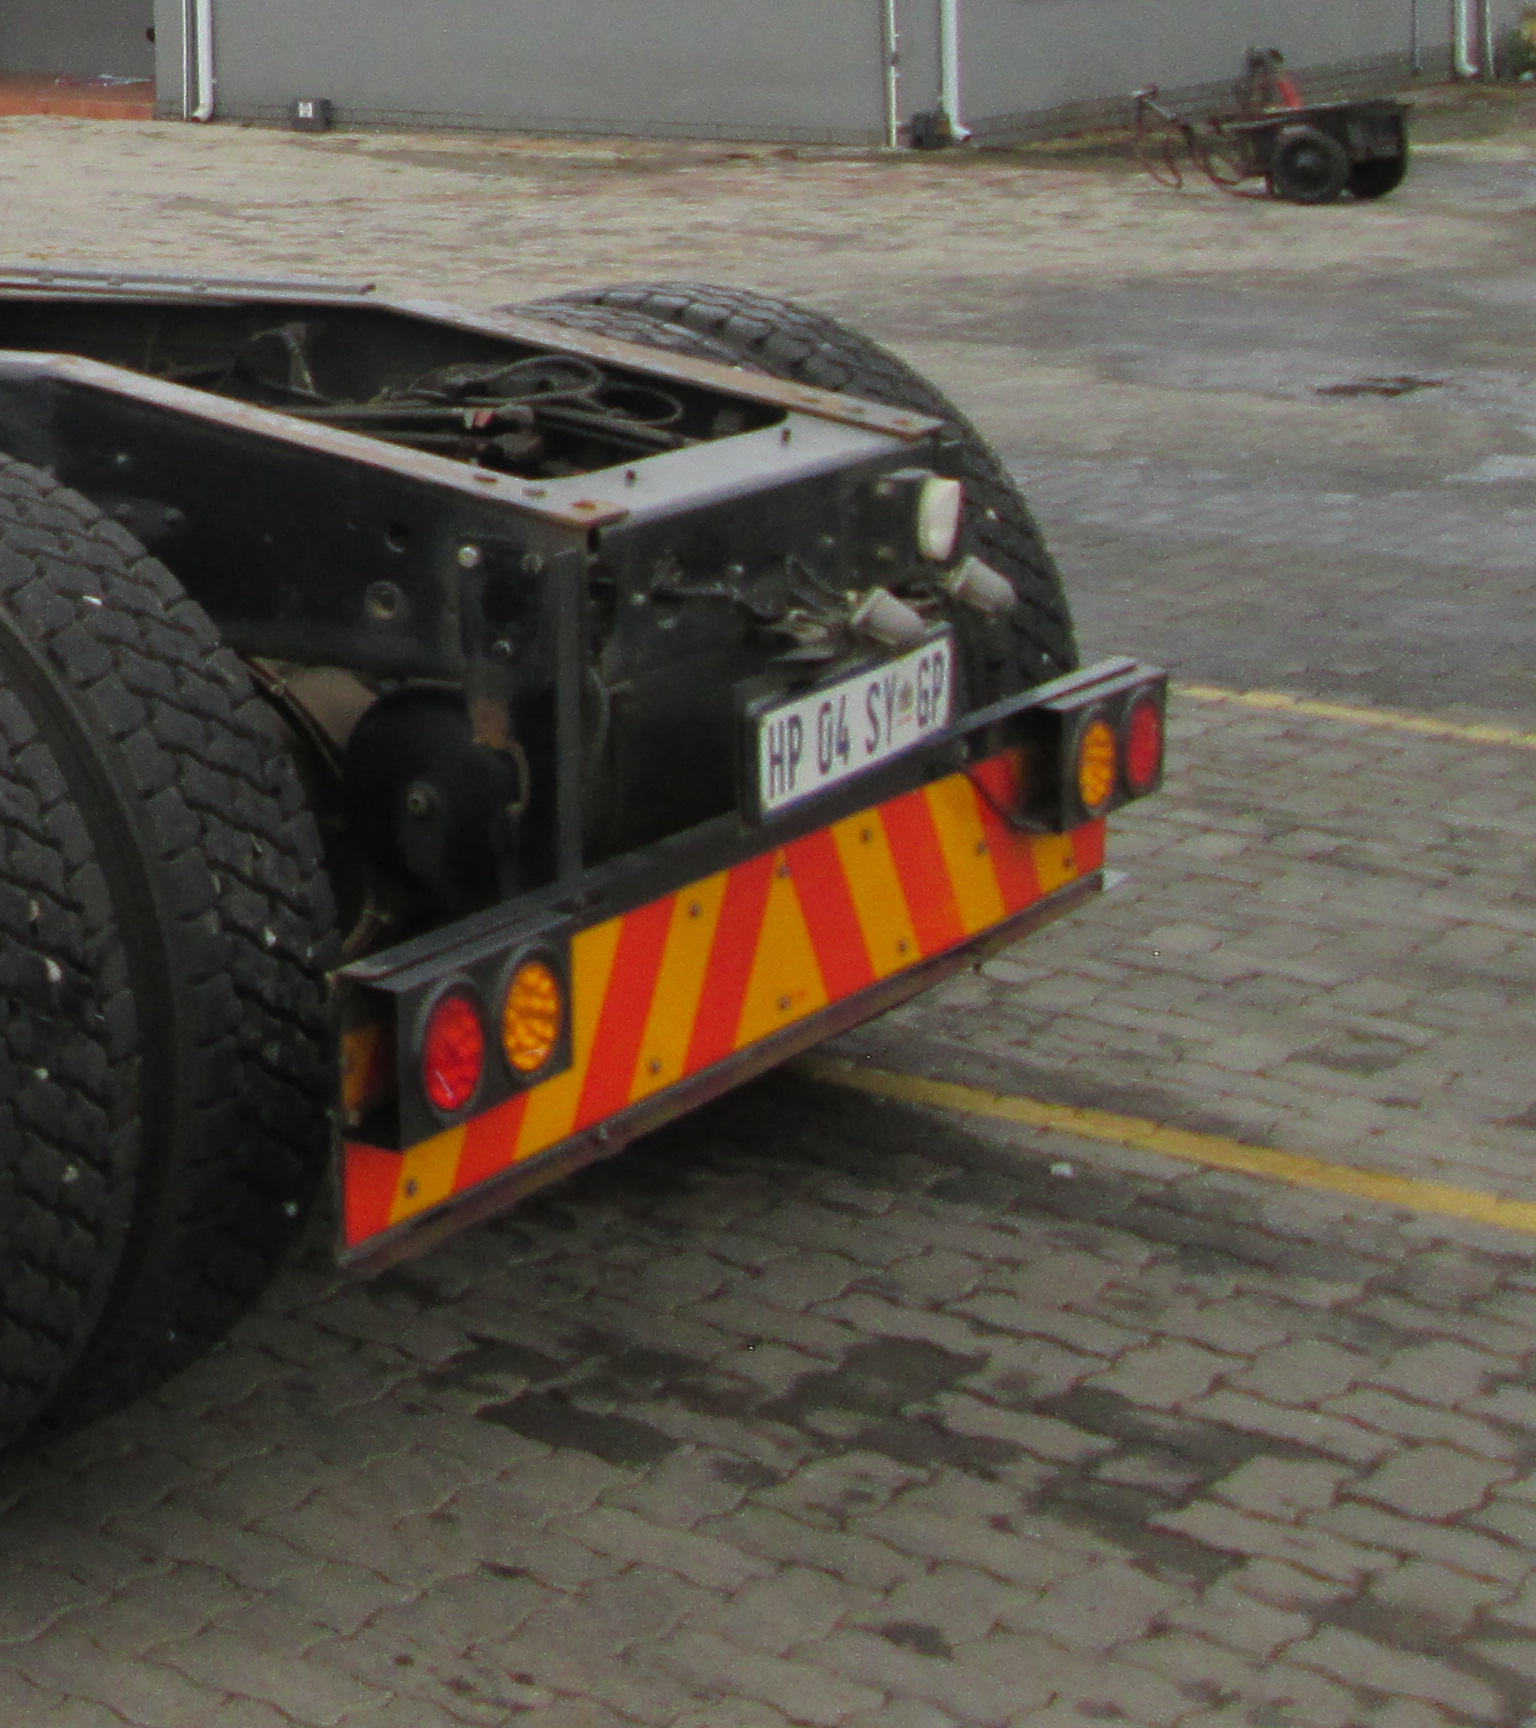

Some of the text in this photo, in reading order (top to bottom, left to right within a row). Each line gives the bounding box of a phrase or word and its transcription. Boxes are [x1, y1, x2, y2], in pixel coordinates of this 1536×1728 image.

[768, 714, 804, 800] HP
[818, 694, 850, 776] 04
[865, 673, 897, 755] SY
